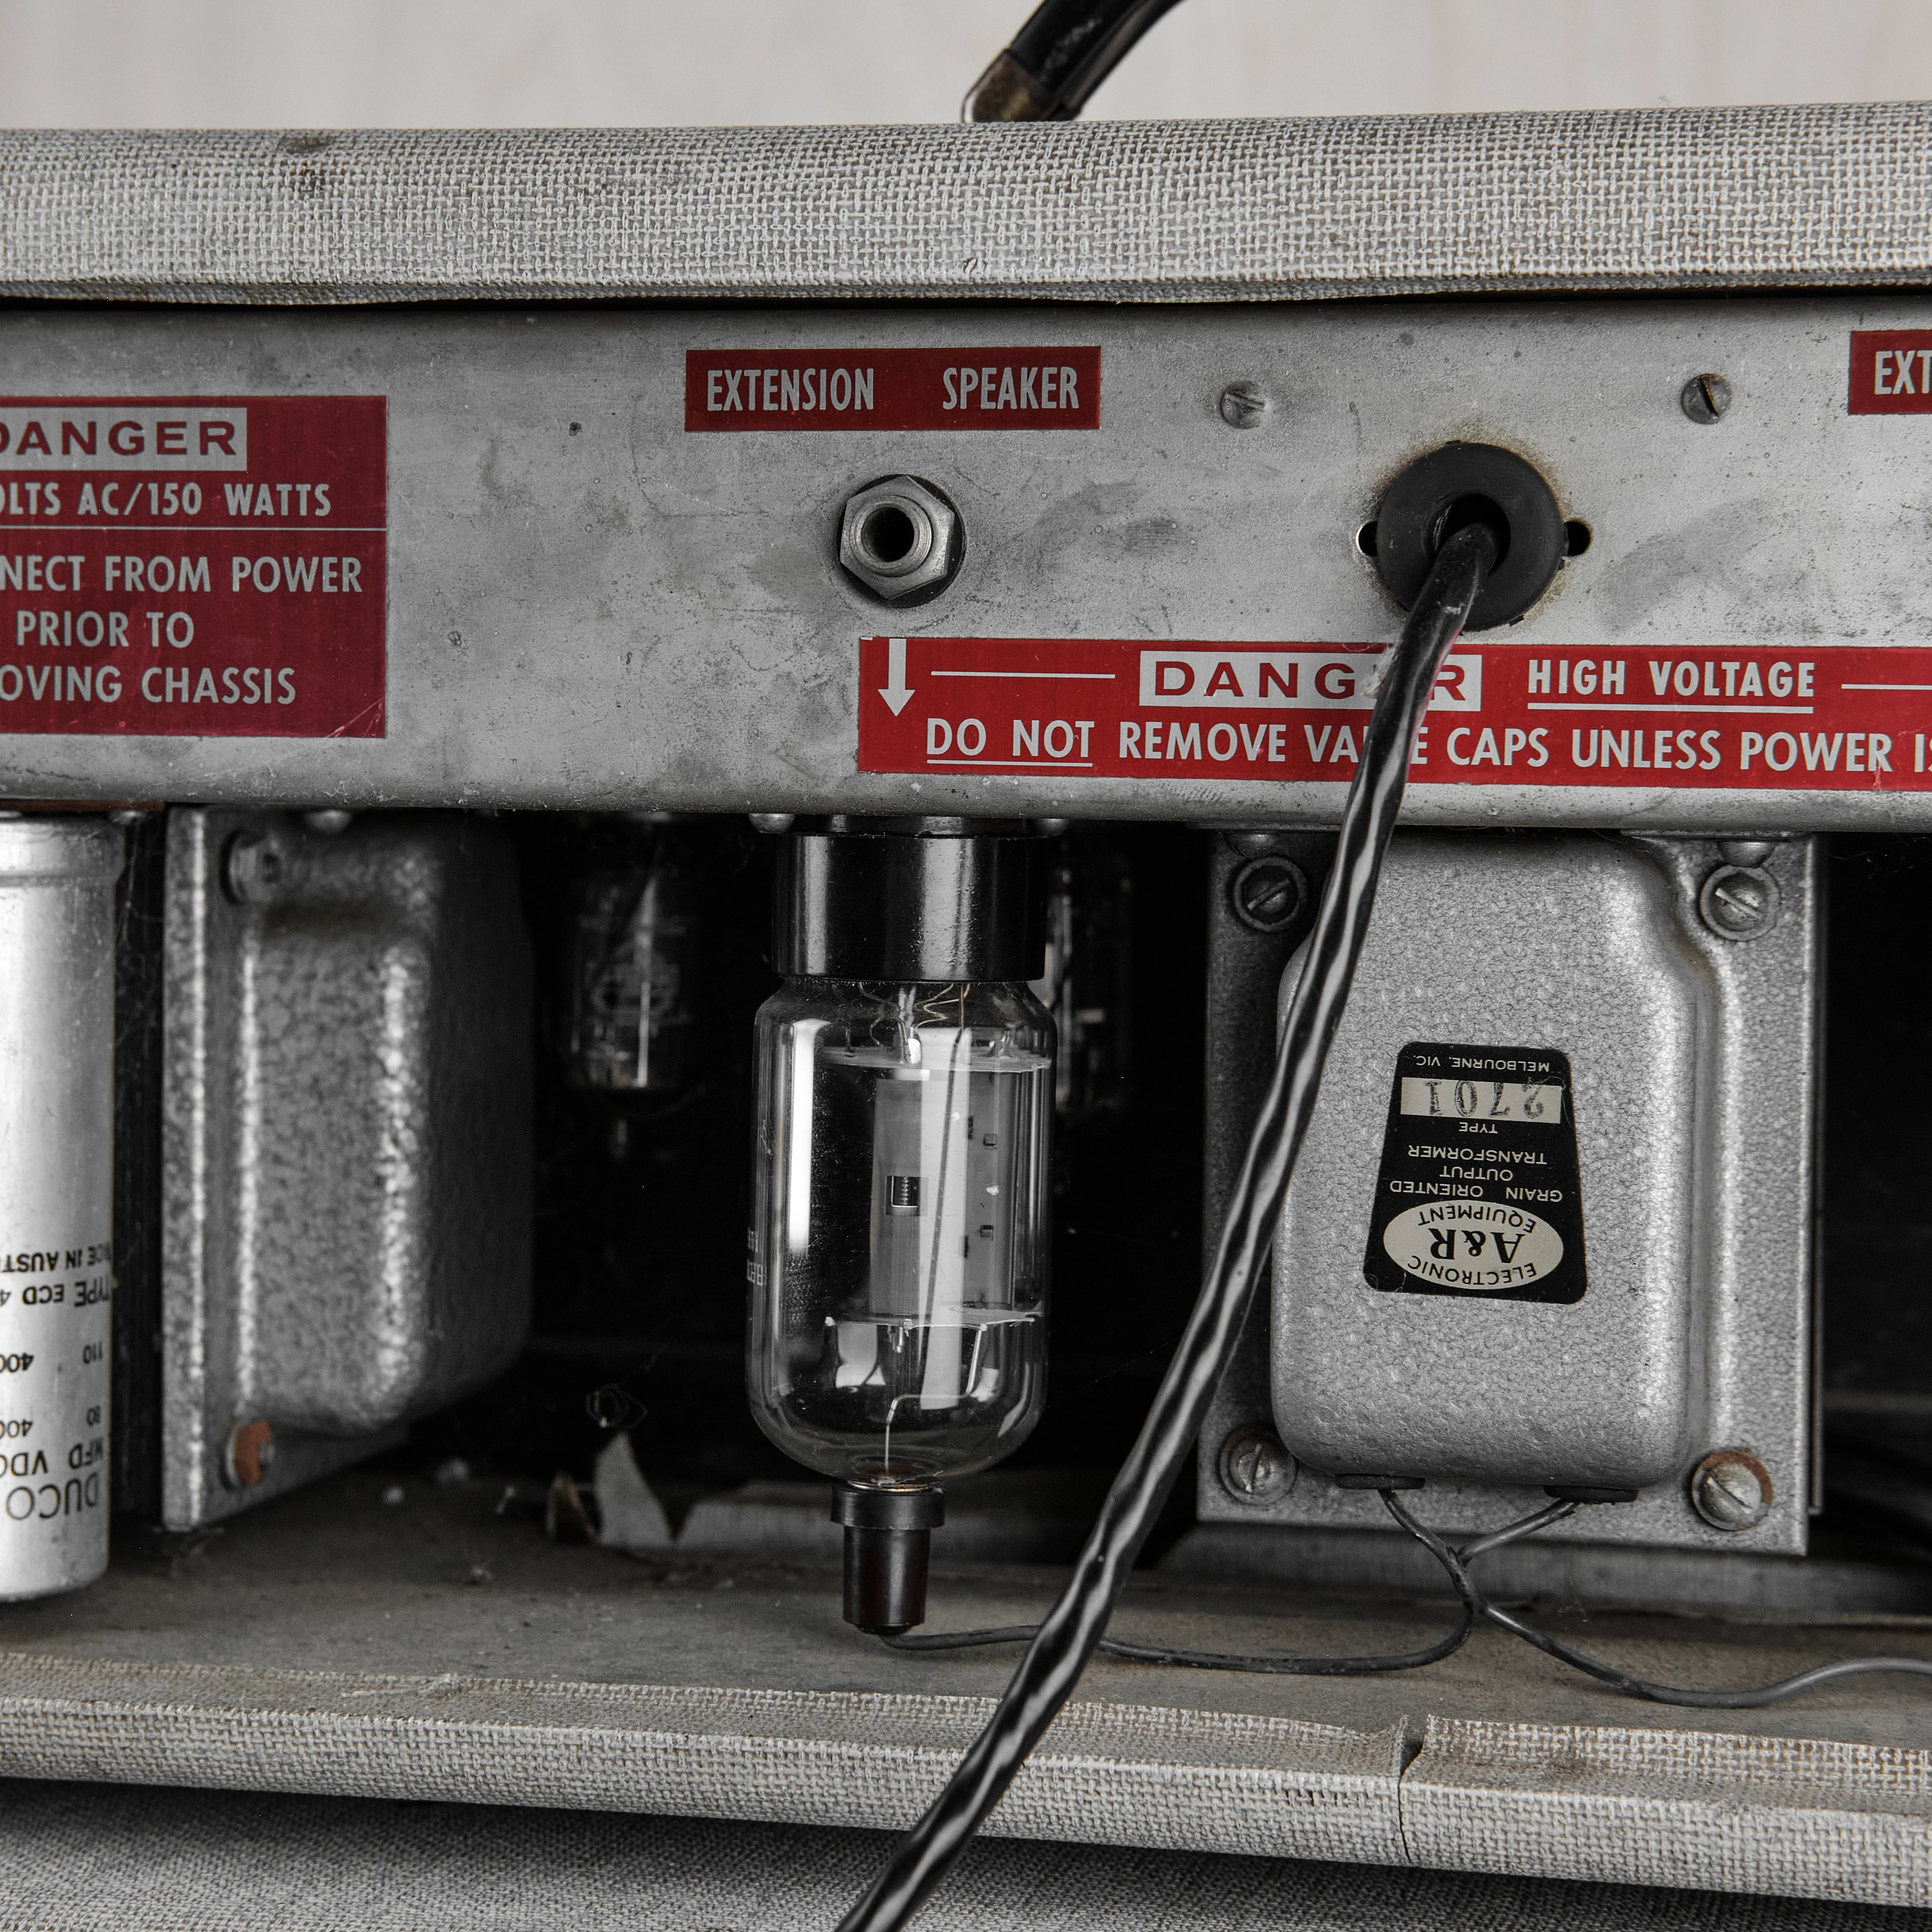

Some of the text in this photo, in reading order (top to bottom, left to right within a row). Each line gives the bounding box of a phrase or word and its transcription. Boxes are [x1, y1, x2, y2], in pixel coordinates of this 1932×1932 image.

[707, 366, 1080, 411] EXTENSION SPEAKER
[1874, 350, 1932, 395] EXT
[0, 420, 236, 456] ANGER
[0, 482, 331, 516] LTS AC/150 WATTS
[105, 555, 211, 593] FROM
[232, 556, 363, 593] POWER
[17, 610, 194, 648] PRIOR TO
[0, 664, 296, 704] OVING CHASSIS
[1155, 659, 1815, 700] DANGR HIGH VOLTAGE
[927, 717, 1932, 772] DO NOT REMOVE VAE CAPS UNLESS POWER I
[1424, 1079, 1545, 1119] 2701
[1458, 1122, 1498, 1134] TYPE
[1408, 1145, 1547, 1165] TRANSFORMER
[1390, 1180, 1563, 1202] GRAIN ORIENTED
[1439, 1166, 1513, 1182] OUTPUT
[1417, 1204, 1538, 1234] EQUIPMENT
[65, 1249, 83, 1269] IN
[1427, 1227, 1526, 1264] A&R
[1406, 1254, 1539, 1287] ELECTRONIC
[22, 1282, 65, 1305] ECD
